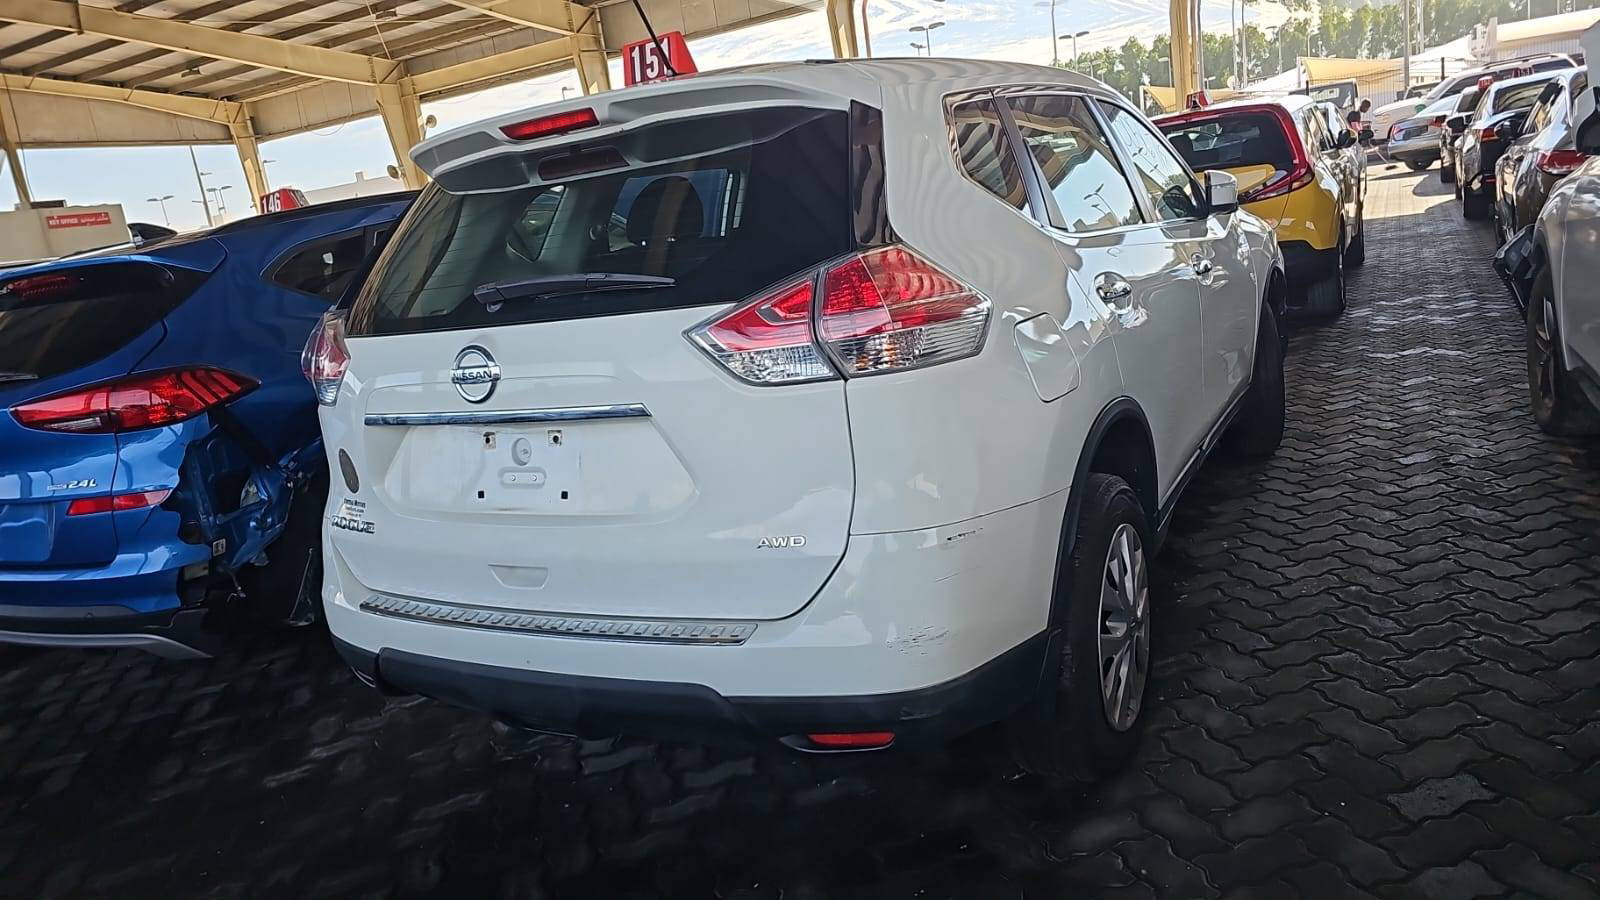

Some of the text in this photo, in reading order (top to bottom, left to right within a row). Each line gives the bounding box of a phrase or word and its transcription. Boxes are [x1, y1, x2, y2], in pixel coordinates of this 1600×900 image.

[631, 37, 670, 82] 151
[262, 192, 281, 214] 146
[452, 369, 492, 381] NISSAN
[756, 535, 807, 549] AWD
